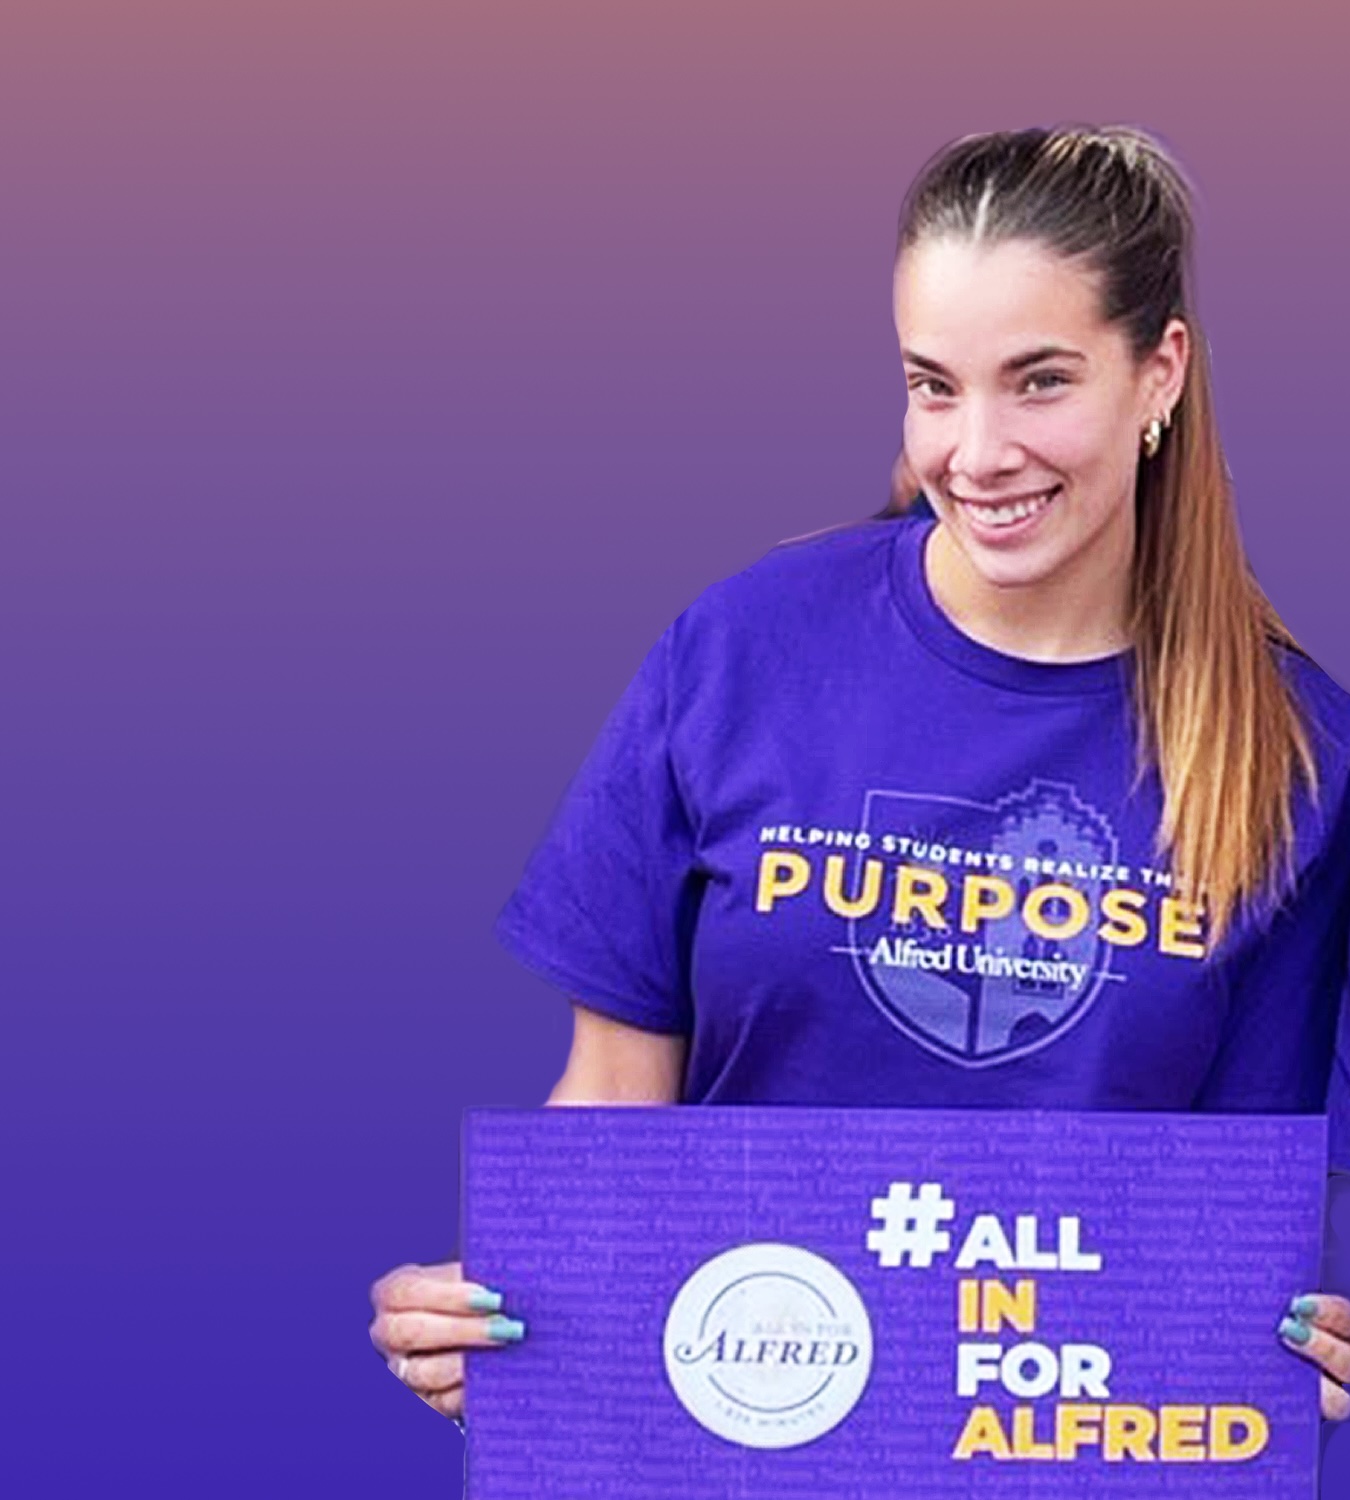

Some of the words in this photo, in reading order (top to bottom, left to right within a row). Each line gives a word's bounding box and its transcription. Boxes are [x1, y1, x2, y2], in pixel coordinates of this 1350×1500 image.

[760, 825, 872, 850] HELPING
[882, 834, 1014, 871] STUDENTS
[1023, 857, 1130, 881] REALIZE
[756, 851, 1205, 958] PURPOSE
[870, 936, 952, 970] Alfred
[957, 945, 1087, 990] University
[867, 1182, 1102, 1271] #ALL
[958, 1279, 1036, 1333] IN
[673, 1329, 860, 1367] ALFRED
[956, 1341, 1112, 1399] FOR
[952, 1404, 1270, 1462] ALFRED
